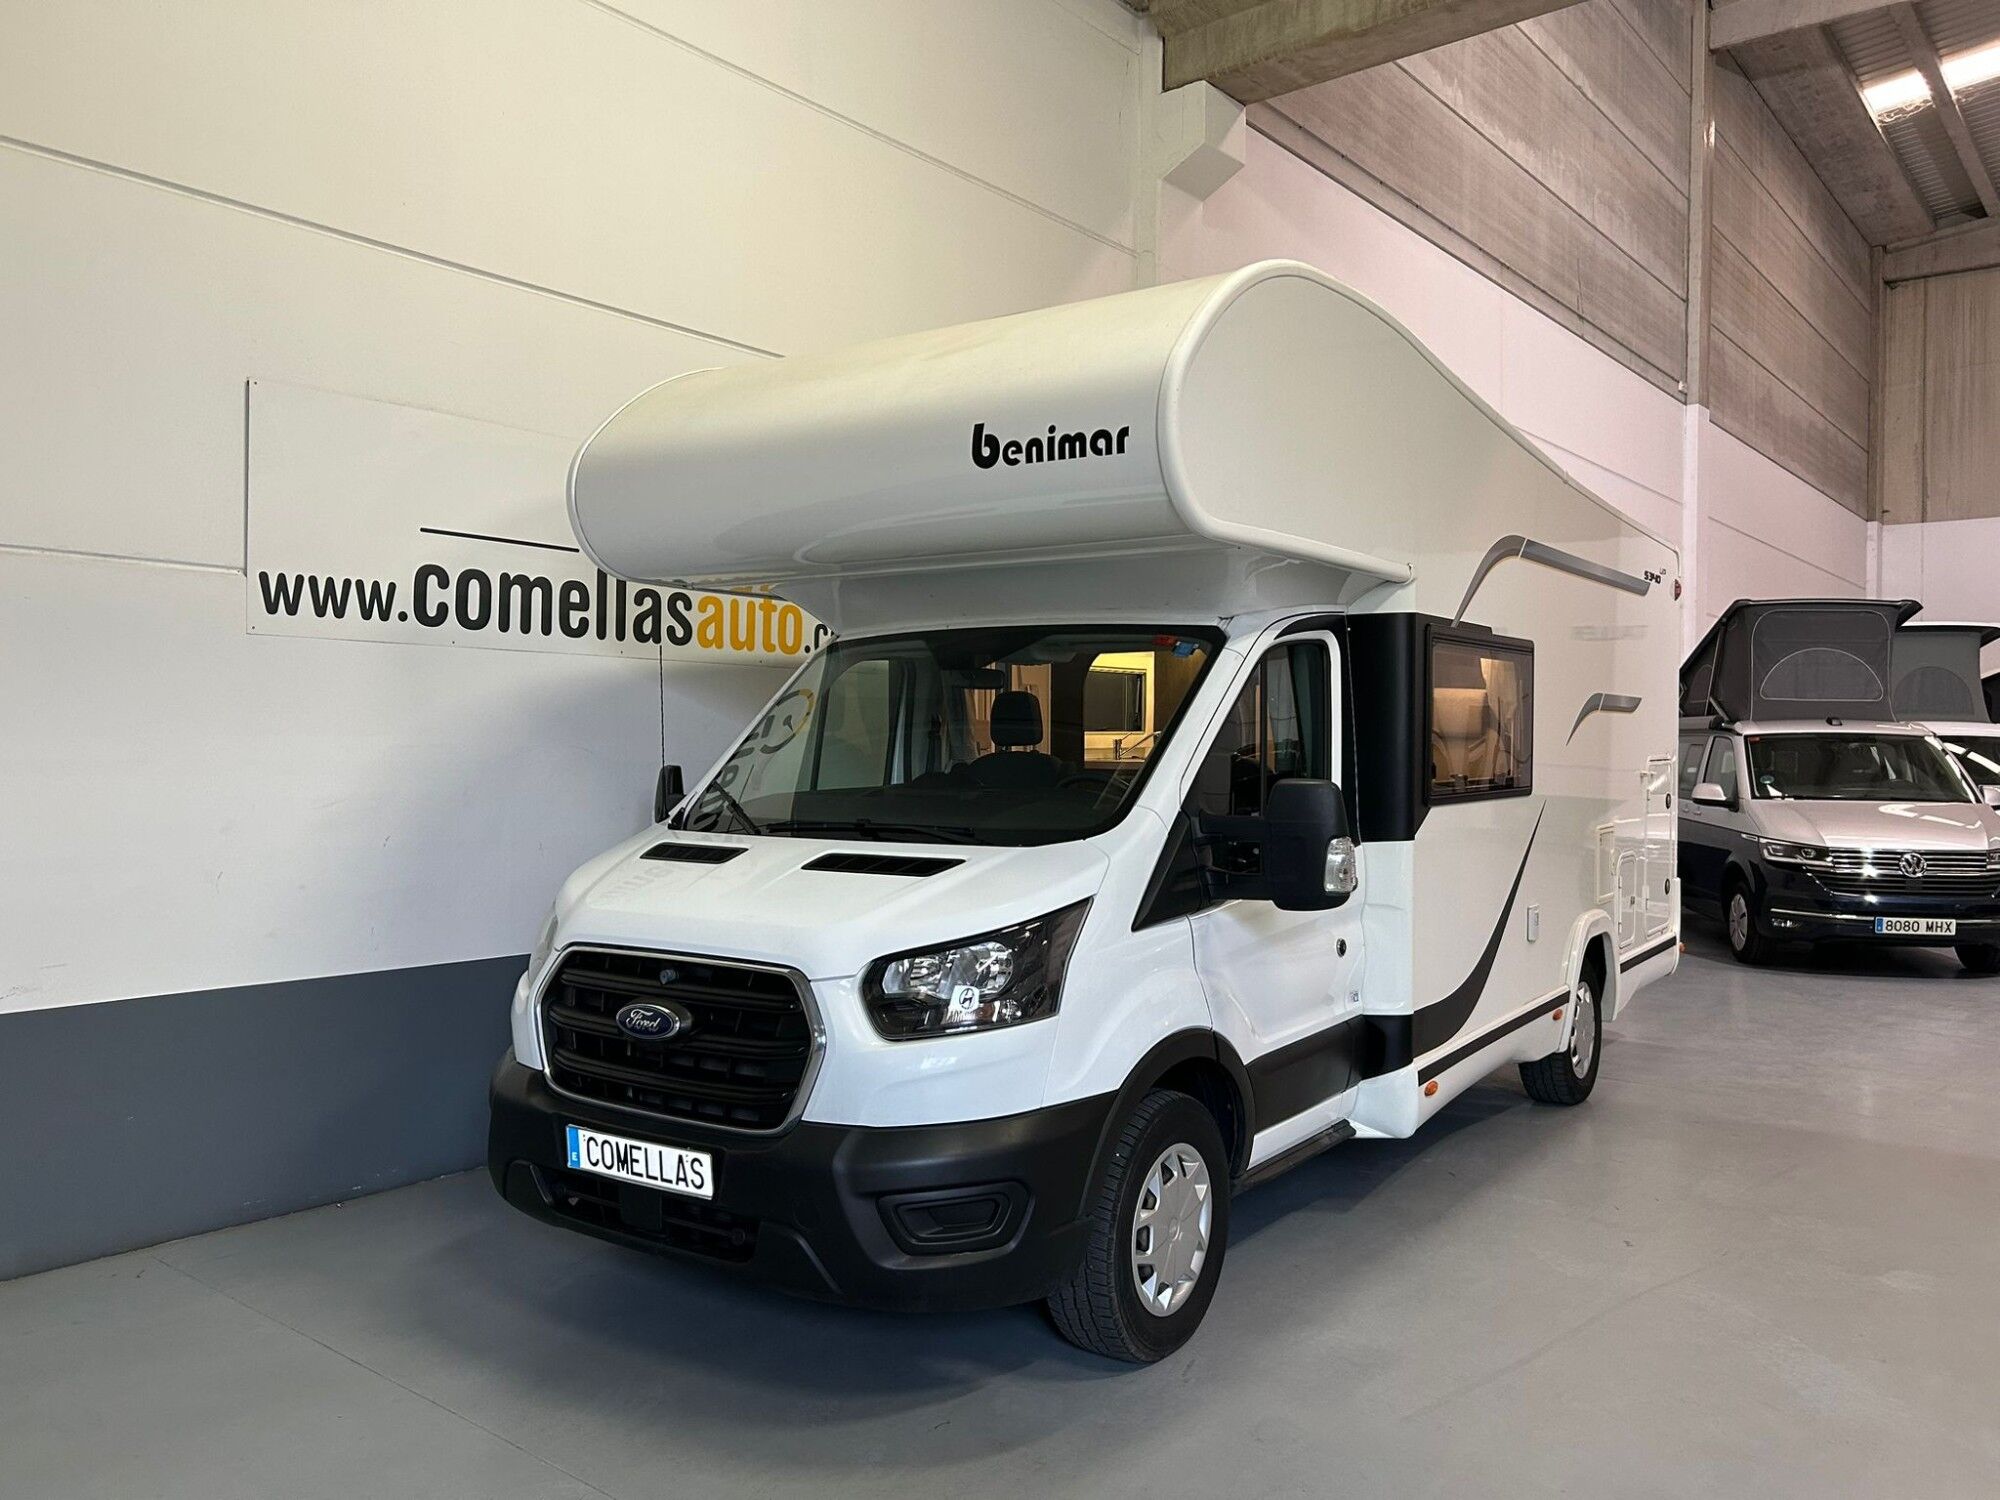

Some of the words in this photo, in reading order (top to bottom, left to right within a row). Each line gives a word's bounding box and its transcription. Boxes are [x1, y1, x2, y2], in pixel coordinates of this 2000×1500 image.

[972, 423, 1130, 469] benimar
[258, 563, 835, 656] www.comellasauto.c
[1885, 920, 1920, 932] 8080
[1925, 920, 1953, 933] MHX
[626, 1008, 662, 1033] Ford
[586, 1136, 705, 1190] COMELLAS
